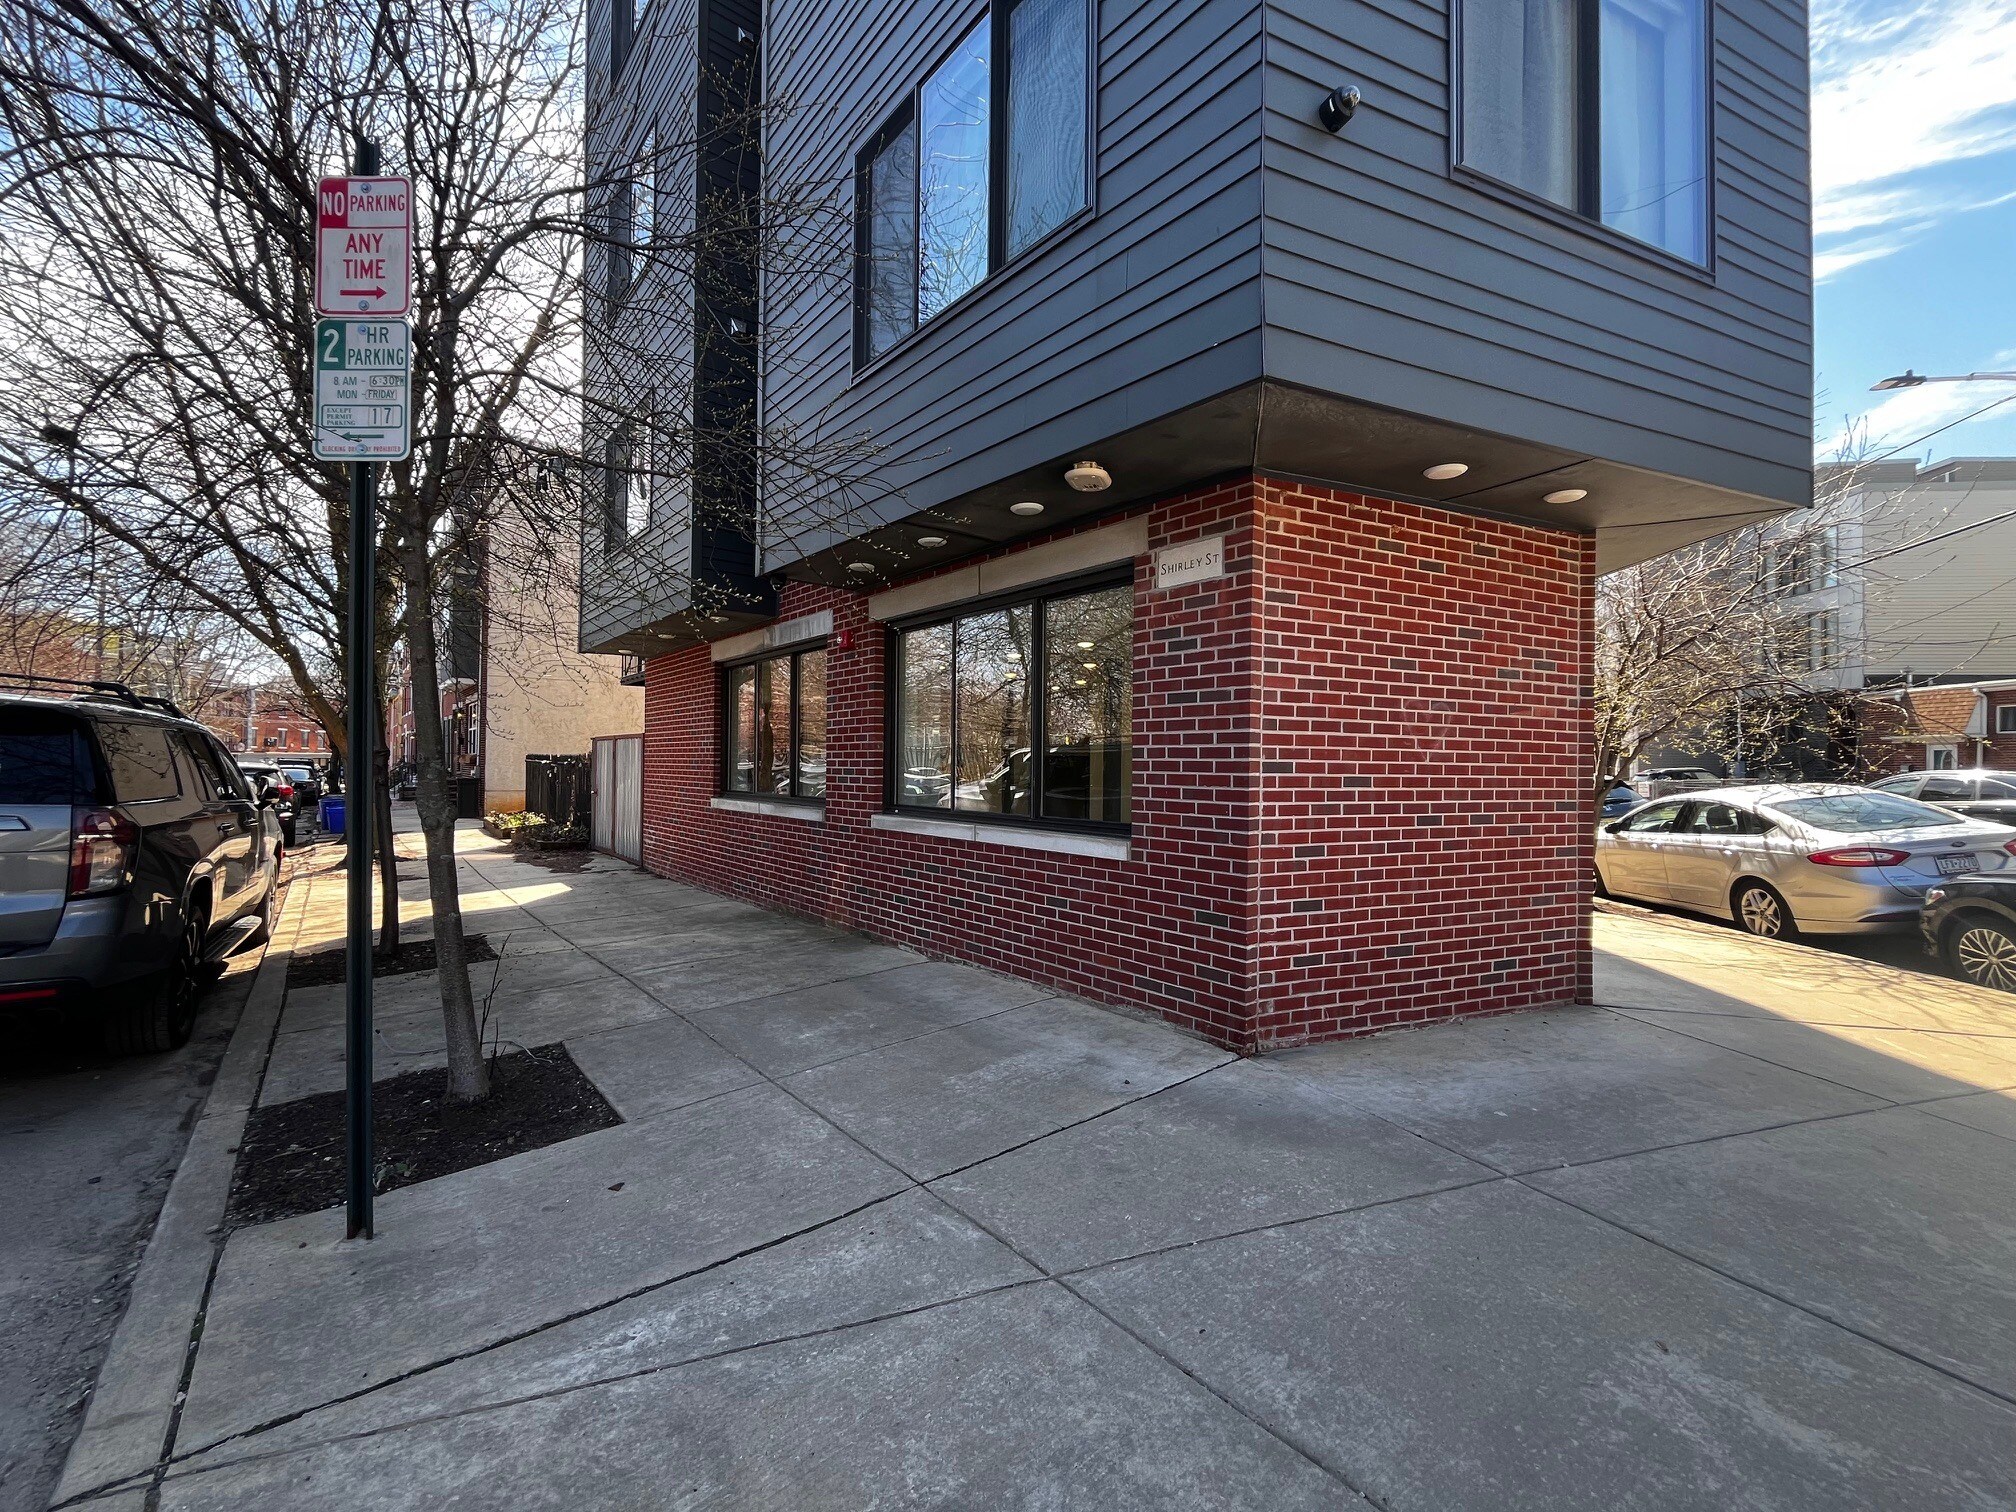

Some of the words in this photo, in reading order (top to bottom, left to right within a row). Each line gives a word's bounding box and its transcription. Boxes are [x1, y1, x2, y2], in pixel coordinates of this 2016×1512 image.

[321, 191, 345, 217] NO
[350, 194, 405, 212] PARKING
[345, 233, 383, 253] ANY
[343, 259, 386, 279] TIME
[323, 328, 340, 363] 2
[366, 327, 389, 343] HR
[347, 349, 404, 365] PARKING
[333, 376, 339, 386] 8
[342, 376, 357, 386] AM
[337, 390, 358, 399] MON
[368, 389, 395, 399] FRIDAY
[1161, 558, 1203, 575] SHIRLEY
[1205, 553, 1219, 566] ST
